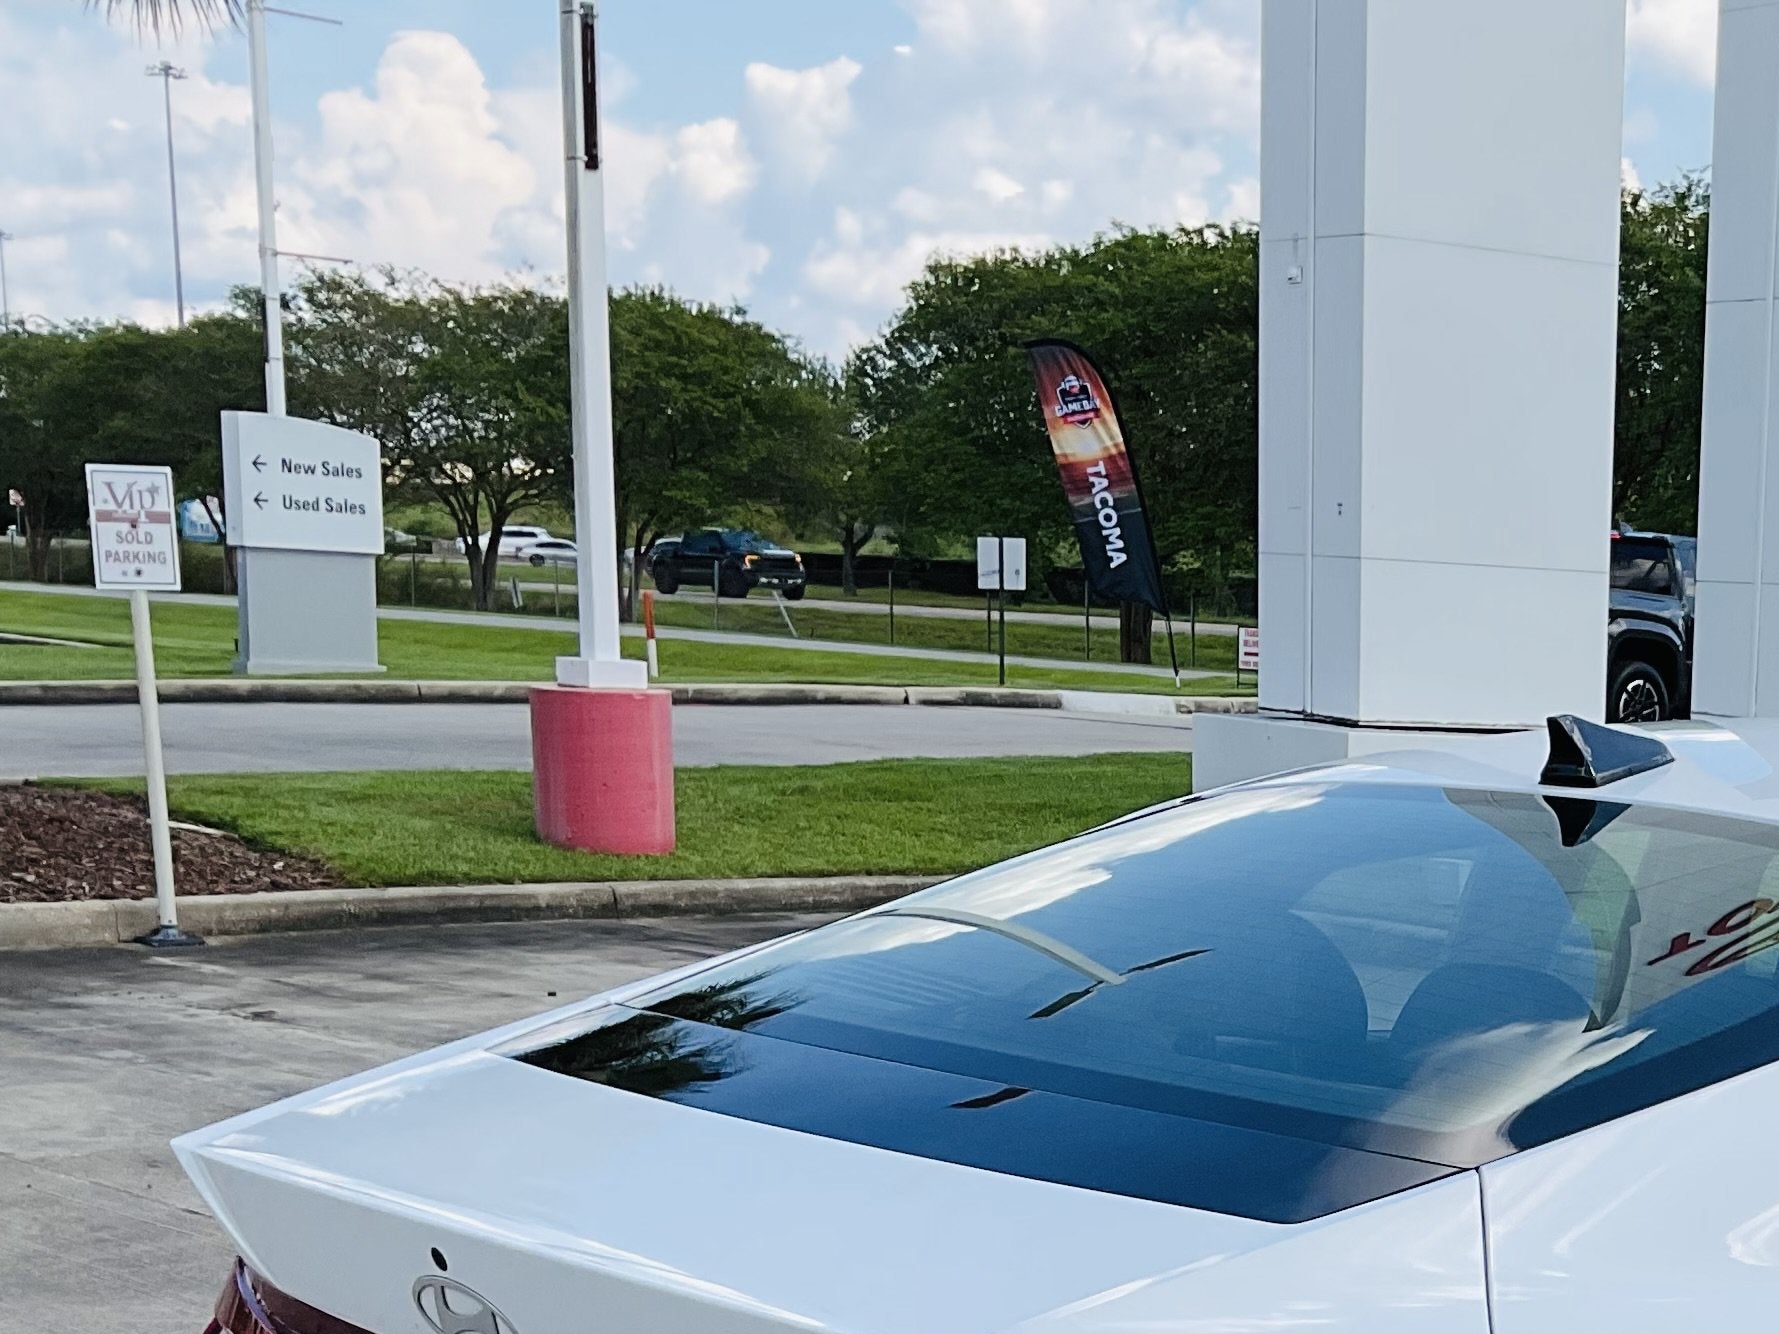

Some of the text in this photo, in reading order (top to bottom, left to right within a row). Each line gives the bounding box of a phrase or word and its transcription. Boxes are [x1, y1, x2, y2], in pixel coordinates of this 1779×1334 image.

[281, 457, 364, 479] New Sales
[282, 494, 366, 515] Used Sales
[1087, 460, 1127, 569] TACOMA
[115, 530, 153, 545] SOLD
[105, 549, 167, 565] PARKING
